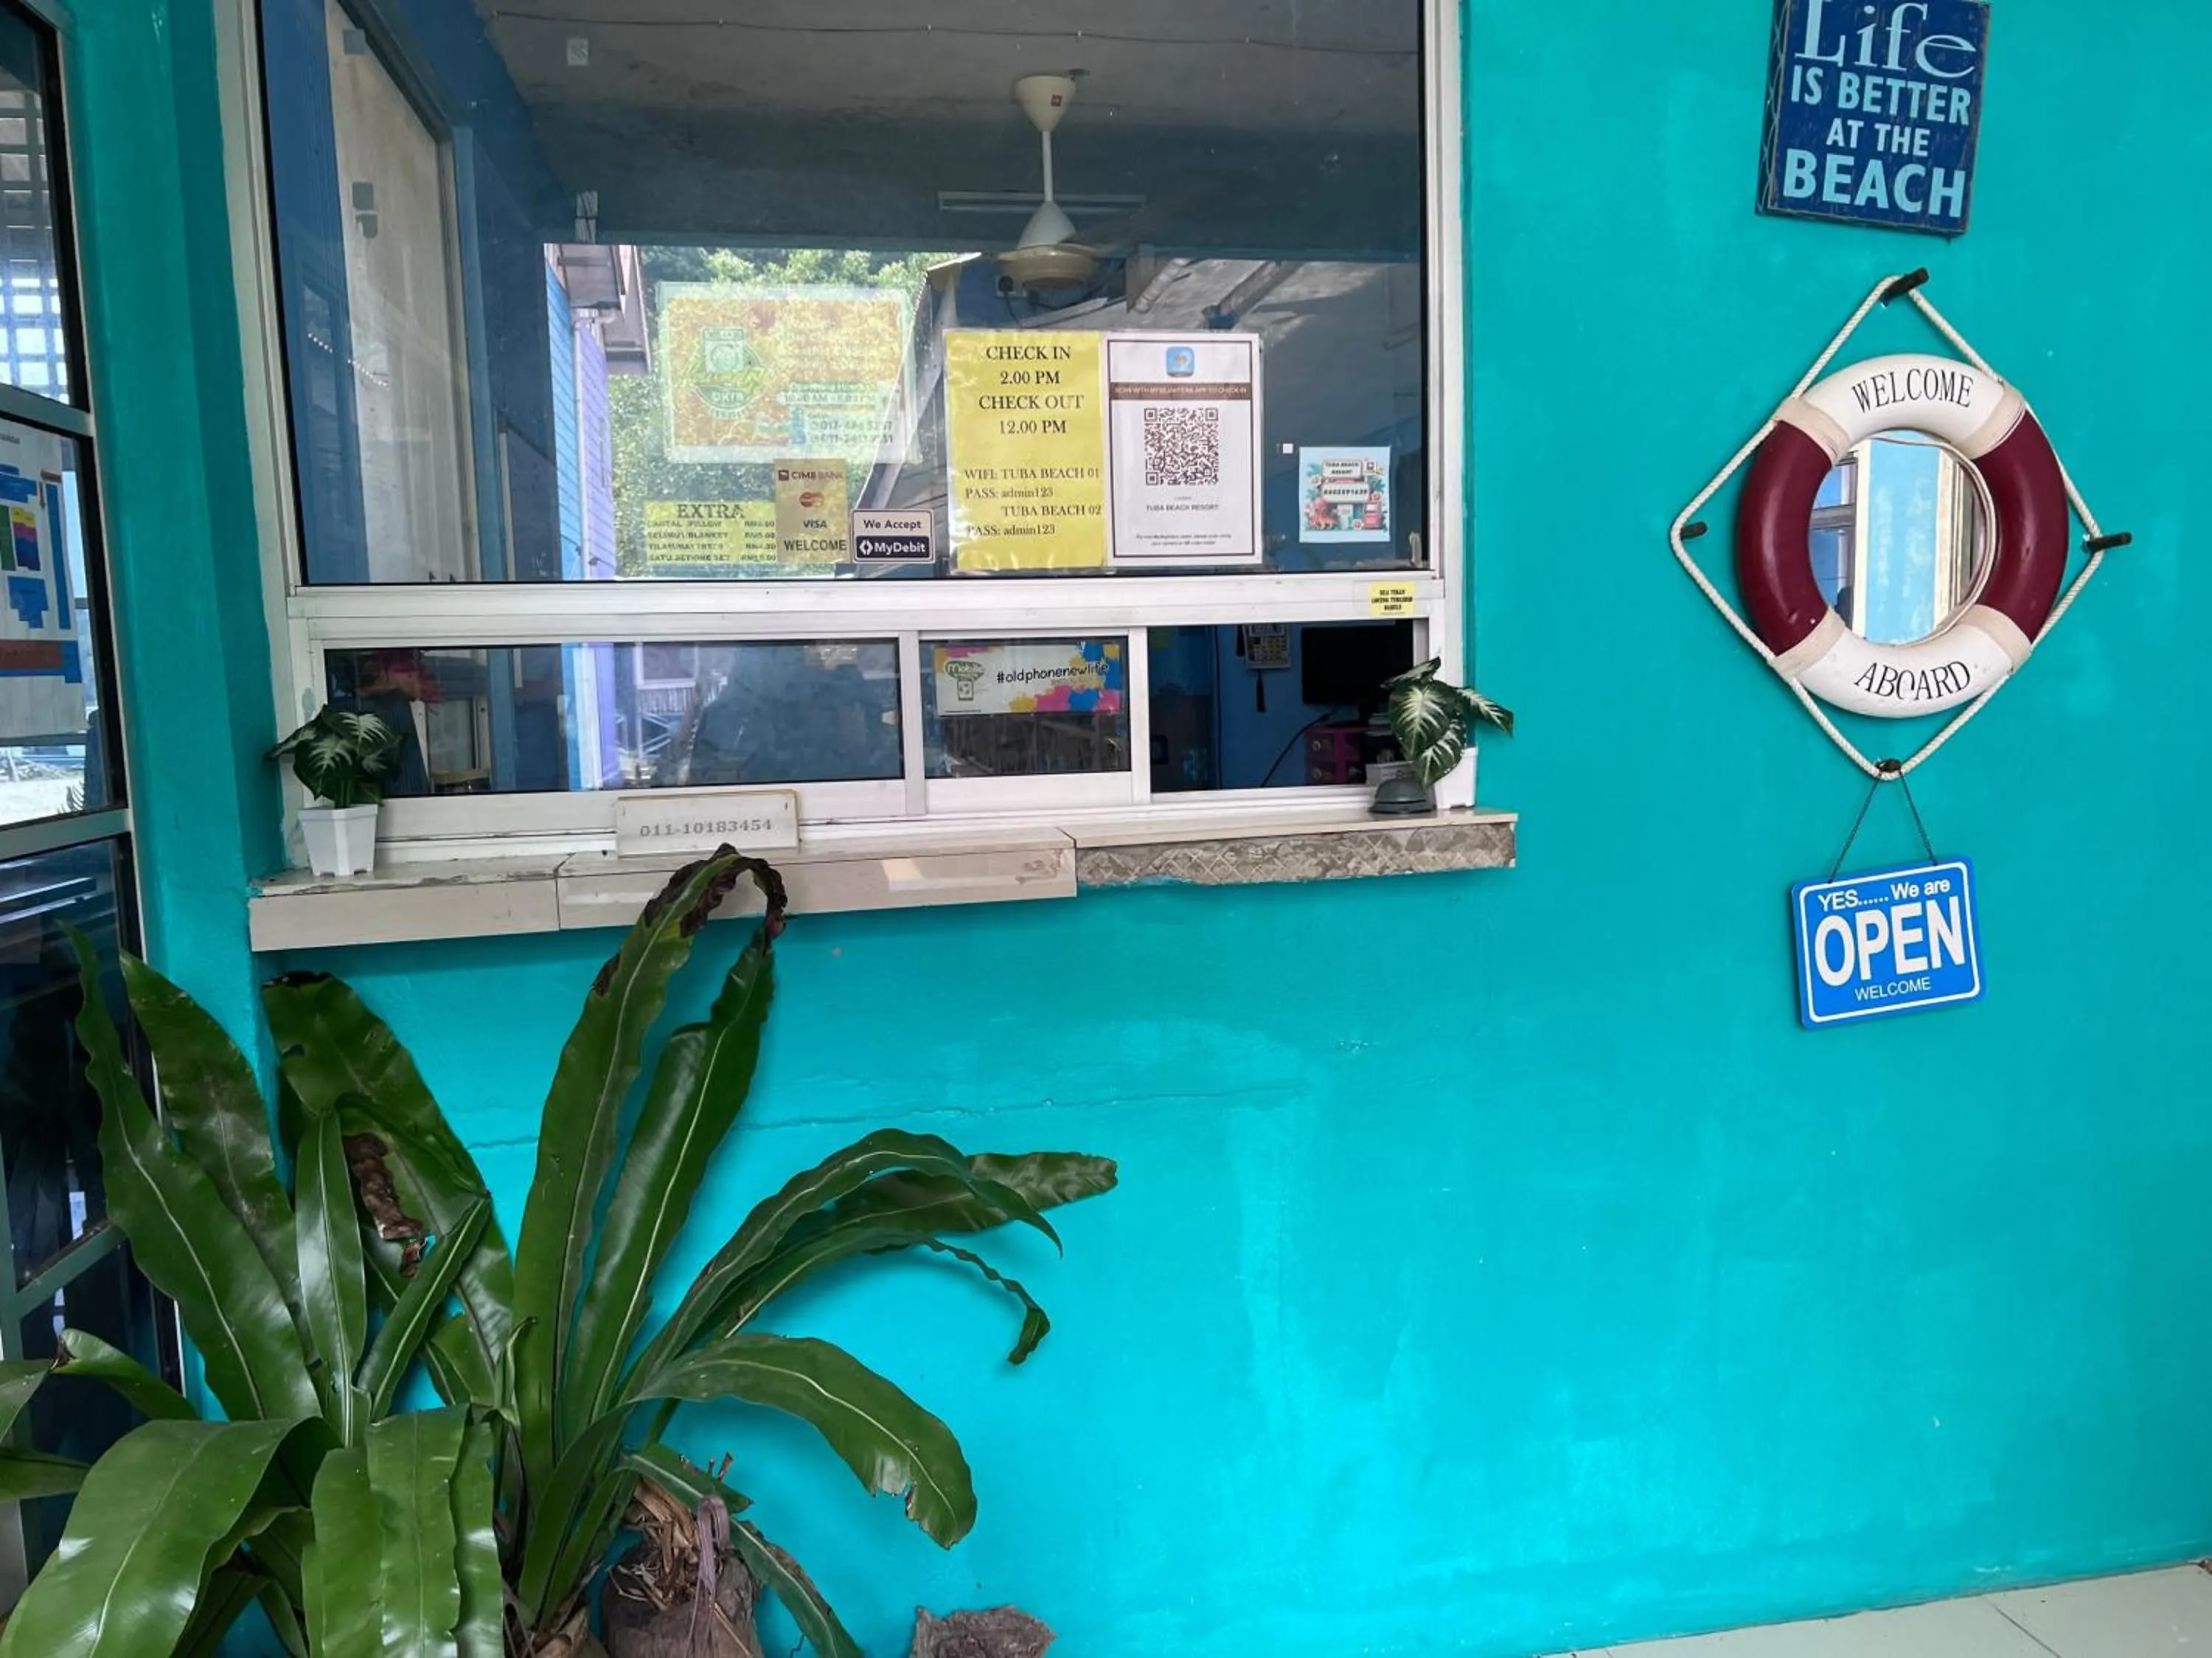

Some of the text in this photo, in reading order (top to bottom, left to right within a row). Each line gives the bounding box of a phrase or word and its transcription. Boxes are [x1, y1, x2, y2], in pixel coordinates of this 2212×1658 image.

[1795, 0, 1976, 77] Life
[1790, 64, 1971, 125] IS BETTER
[1826, 117, 1930, 157] AT THE
[1783, 148, 1966, 218] BEACH
[986, 346, 1071, 360] CHECK IN
[1001, 371, 1060, 384] 2.00 PM
[1851, 368, 1974, 413] WELCOME
[979, 395, 1084, 409] CHECK OUT
[1001, 420, 1066, 434] 12.00 PM
[791, 471, 844, 479] CIMB BANK
[964, 468, 1099, 479] WIFI: TUBA BEACH 01
[966, 487, 1054, 499] PASS: admin123
[678, 504, 745, 519] EXTRA
[1001, 505, 1102, 516] TUBA BEACH 02
[803, 520, 827, 529] VISA
[863, 519, 921, 531] We Accept
[1004, 524, 1055, 535] admin123
[784, 539, 847, 552] WELCOME
[874, 541, 925, 555] MyDebit
[996, 661, 1110, 684] #oldphonenewlife
[640, 819, 772, 838] 011-10183454
[1890, 881, 1919, 901] We
[1924, 878, 1950, 895] are
[1815, 895, 1966, 987] OPEN
[1854, 977, 1933, 1002] WELCOME
